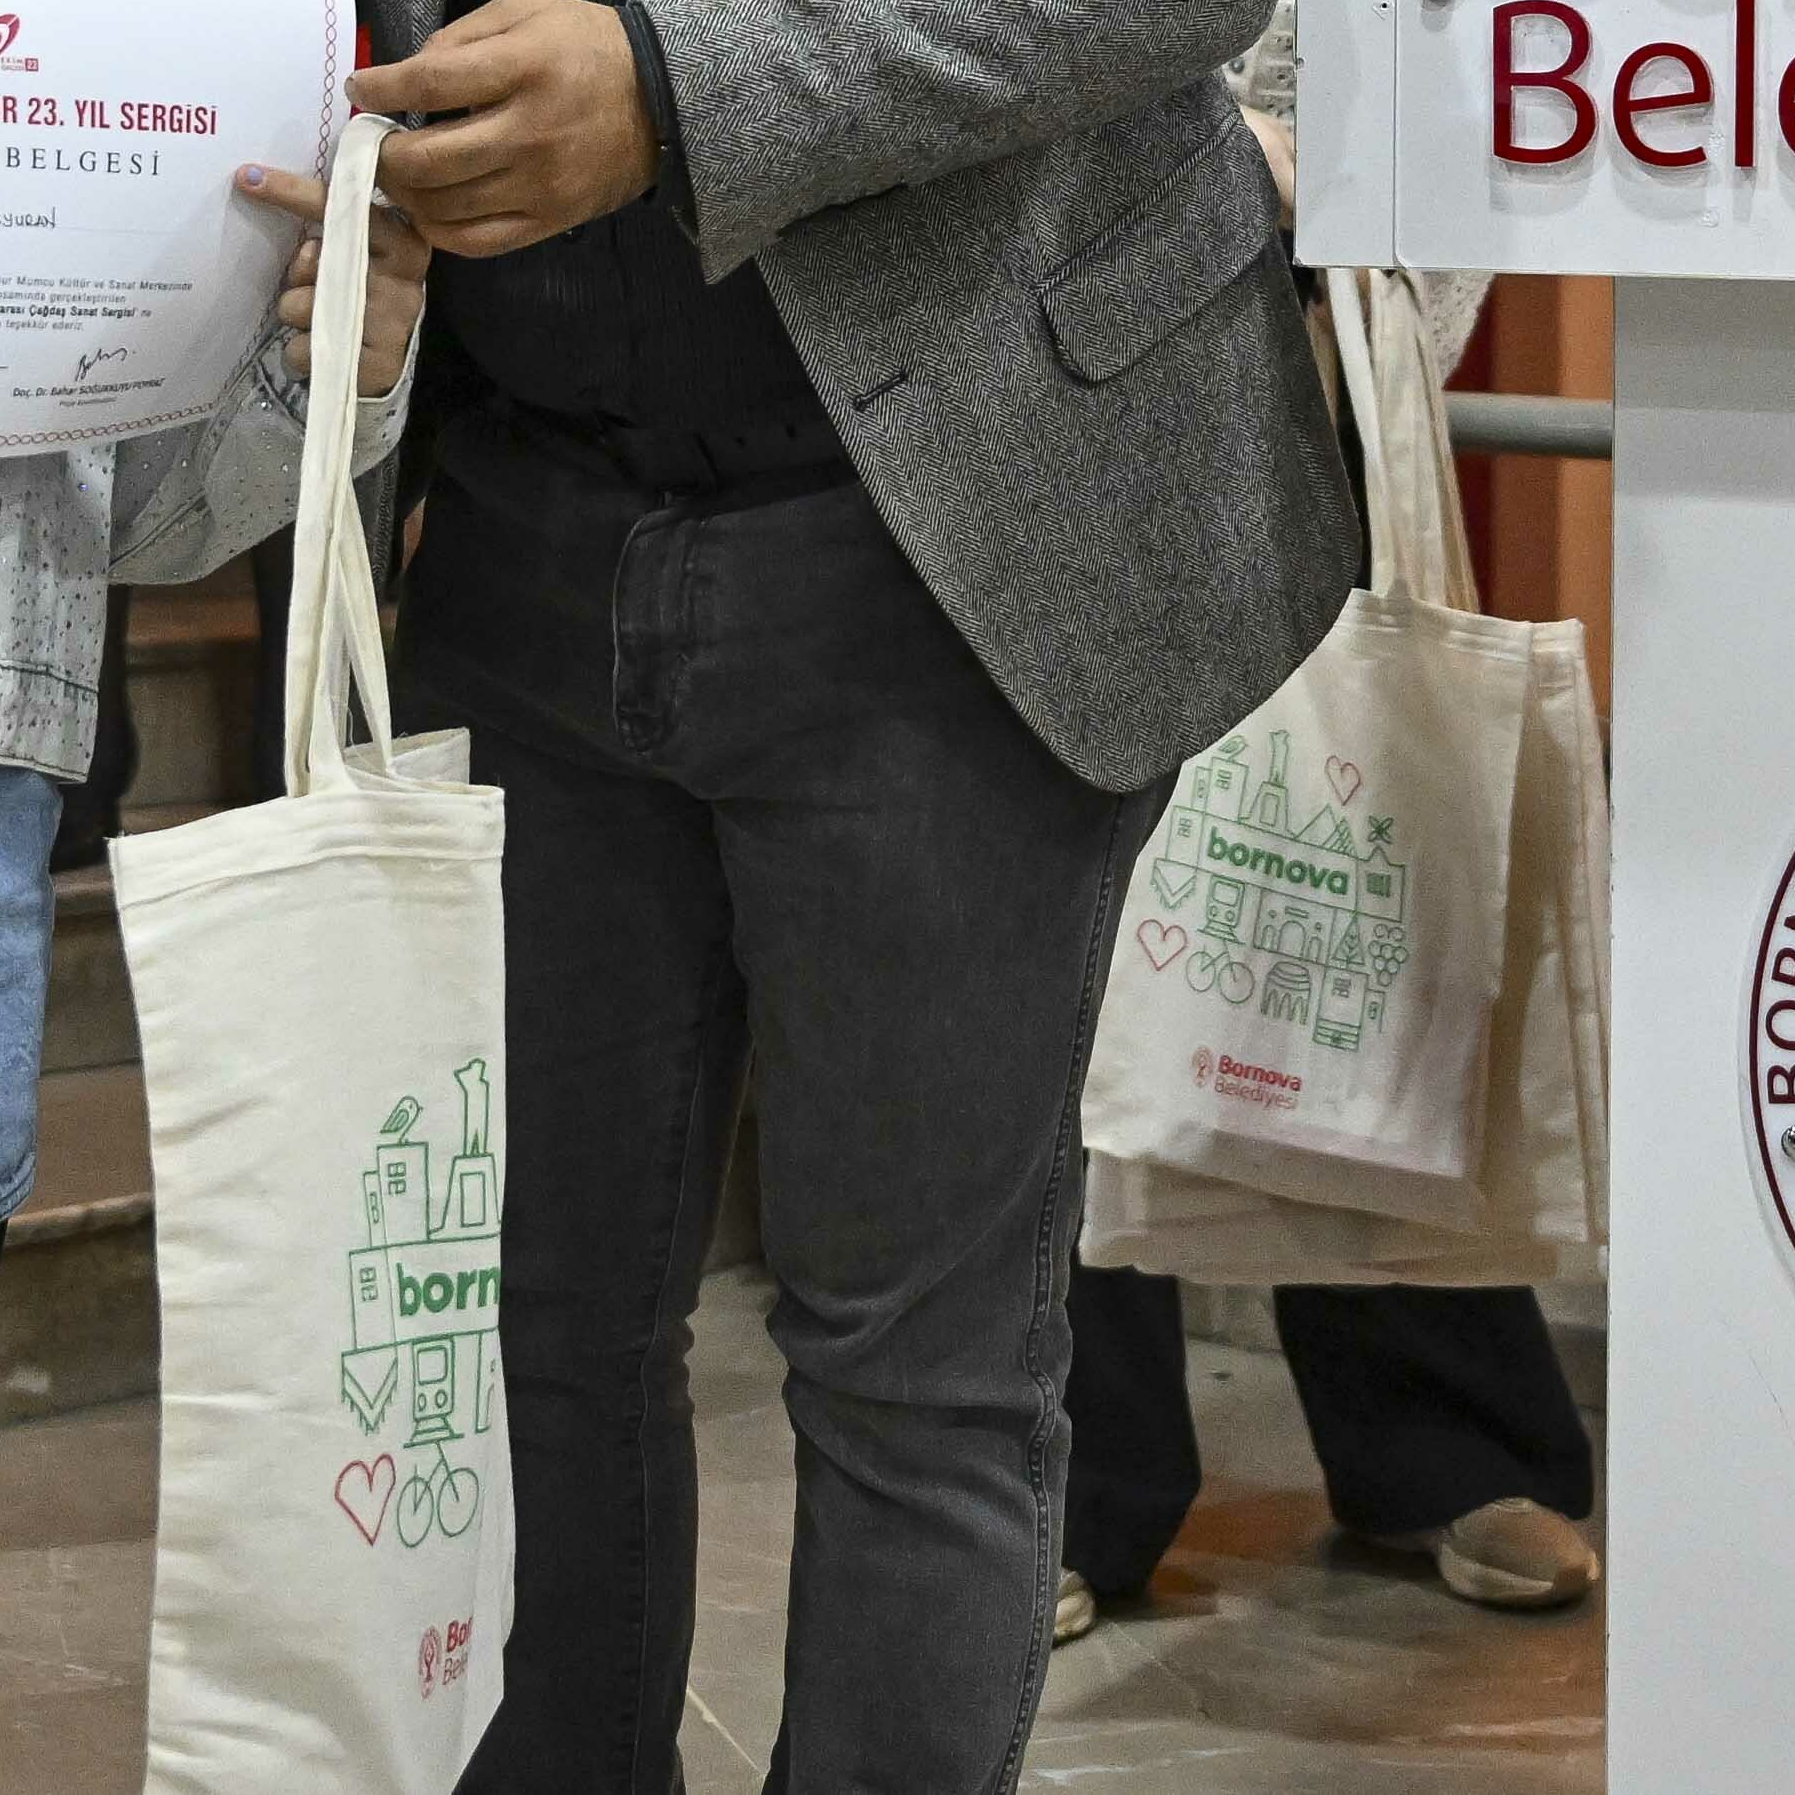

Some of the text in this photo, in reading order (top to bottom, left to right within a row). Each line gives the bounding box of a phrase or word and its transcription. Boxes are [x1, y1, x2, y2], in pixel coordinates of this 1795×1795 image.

[27, 97, 64, 126] 23.
[75, 99, 111, 129] YIL
[120, 102, 218, 135] SERGİSİ
[6, 146, 161, 175] BELGESİ
[1207, 826, 1349, 895] bornova
[1217, 1054, 1302, 1092] Bornova
